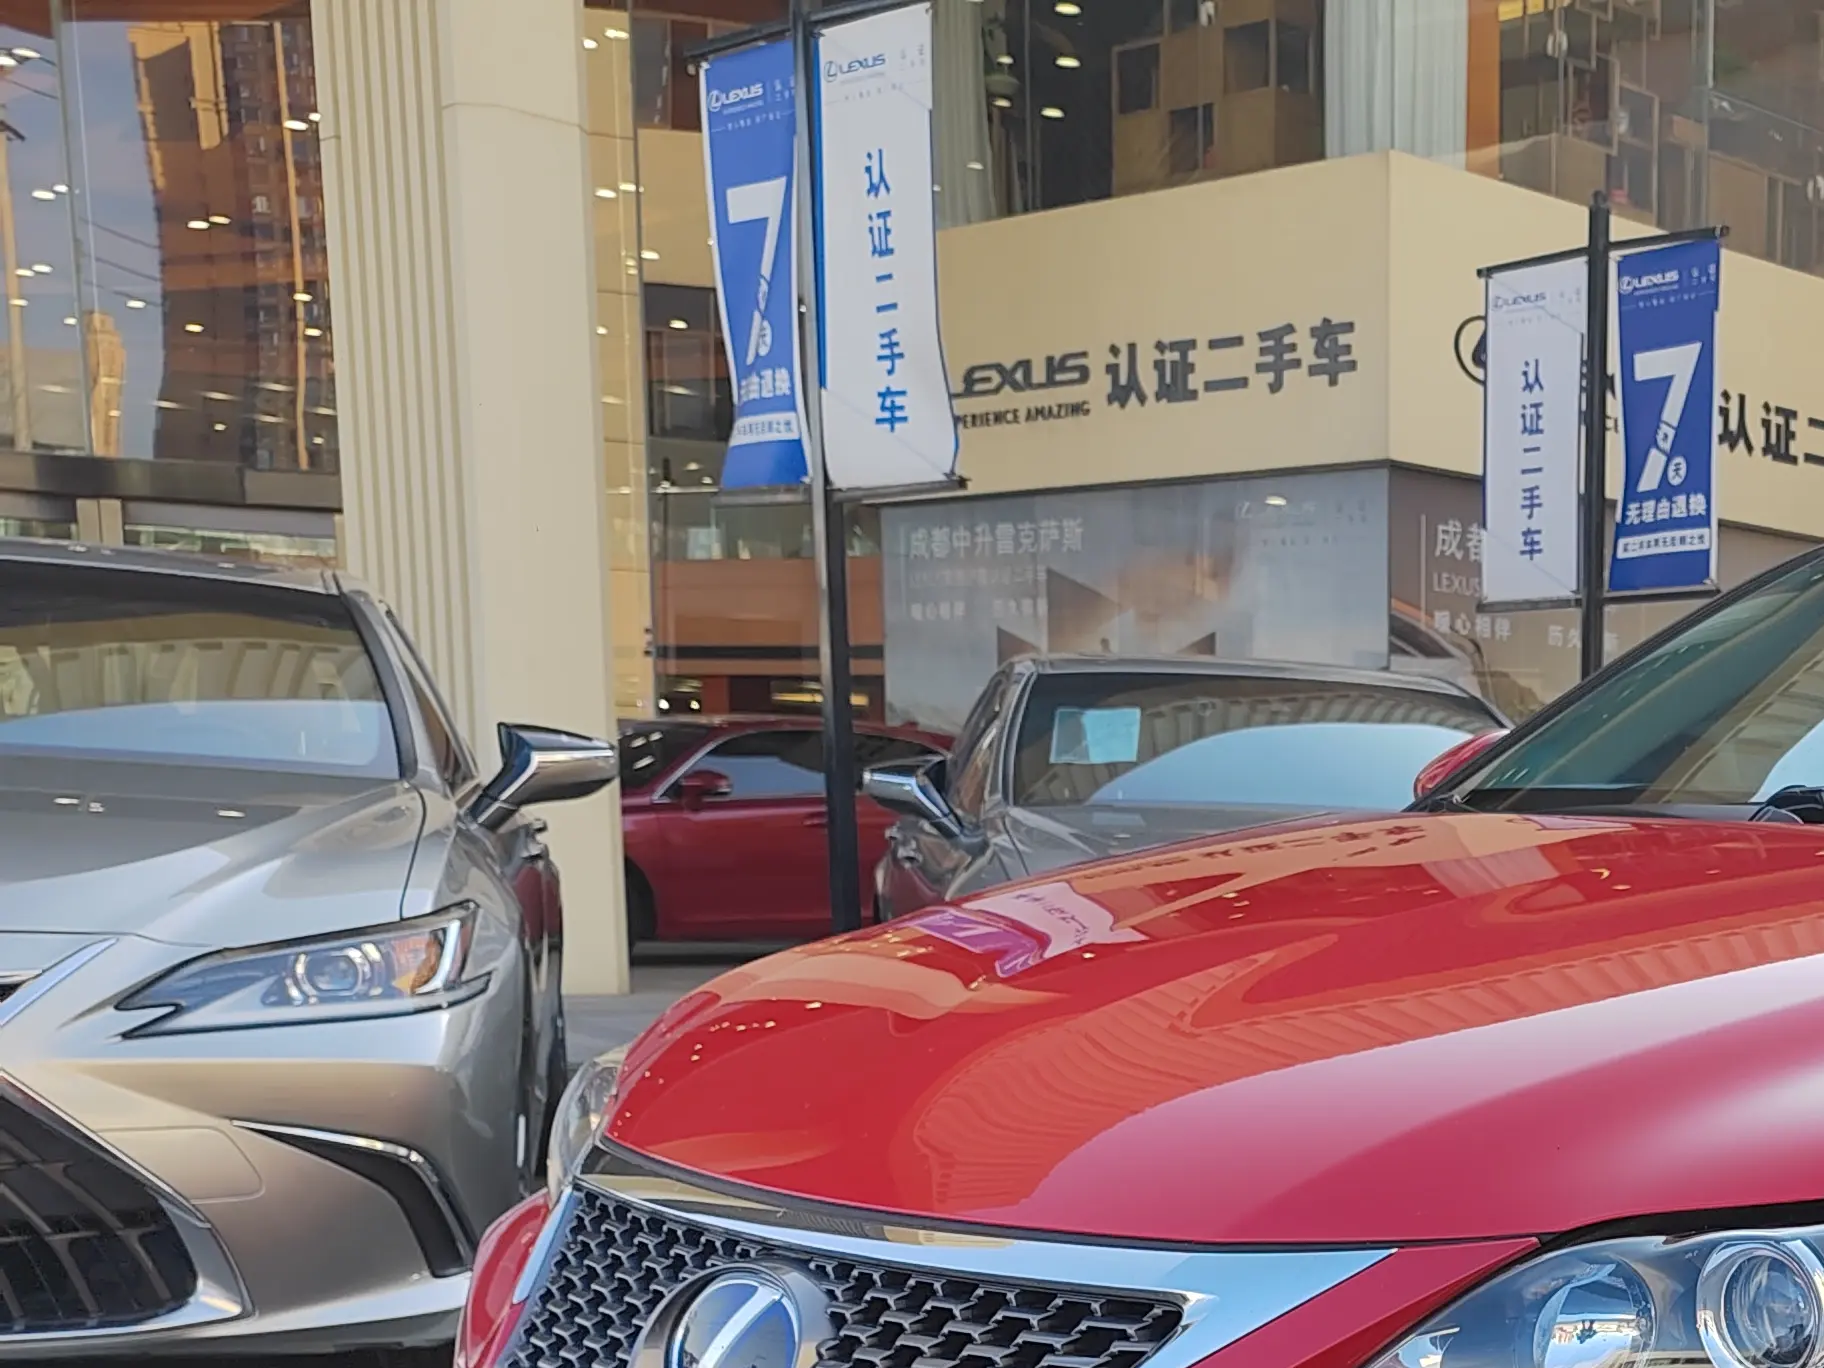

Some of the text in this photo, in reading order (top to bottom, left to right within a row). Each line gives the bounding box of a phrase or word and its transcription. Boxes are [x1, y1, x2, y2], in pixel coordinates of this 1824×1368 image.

[720, 82, 764, 105] LEXUS
[839, 54, 886, 74] LEXUS
[726, 176, 787, 366] 7
[863, 148, 909, 433] 认证二手车
[950, 317, 1358, 409] EXUS 认证二手车
[1025, 400, 1091, 423] AMAZING
[1633, 342, 1702, 493] 7
[1519, 358, 1545, 561] 认证二手车
[1625, 493, 1708, 525] 无理由退换
